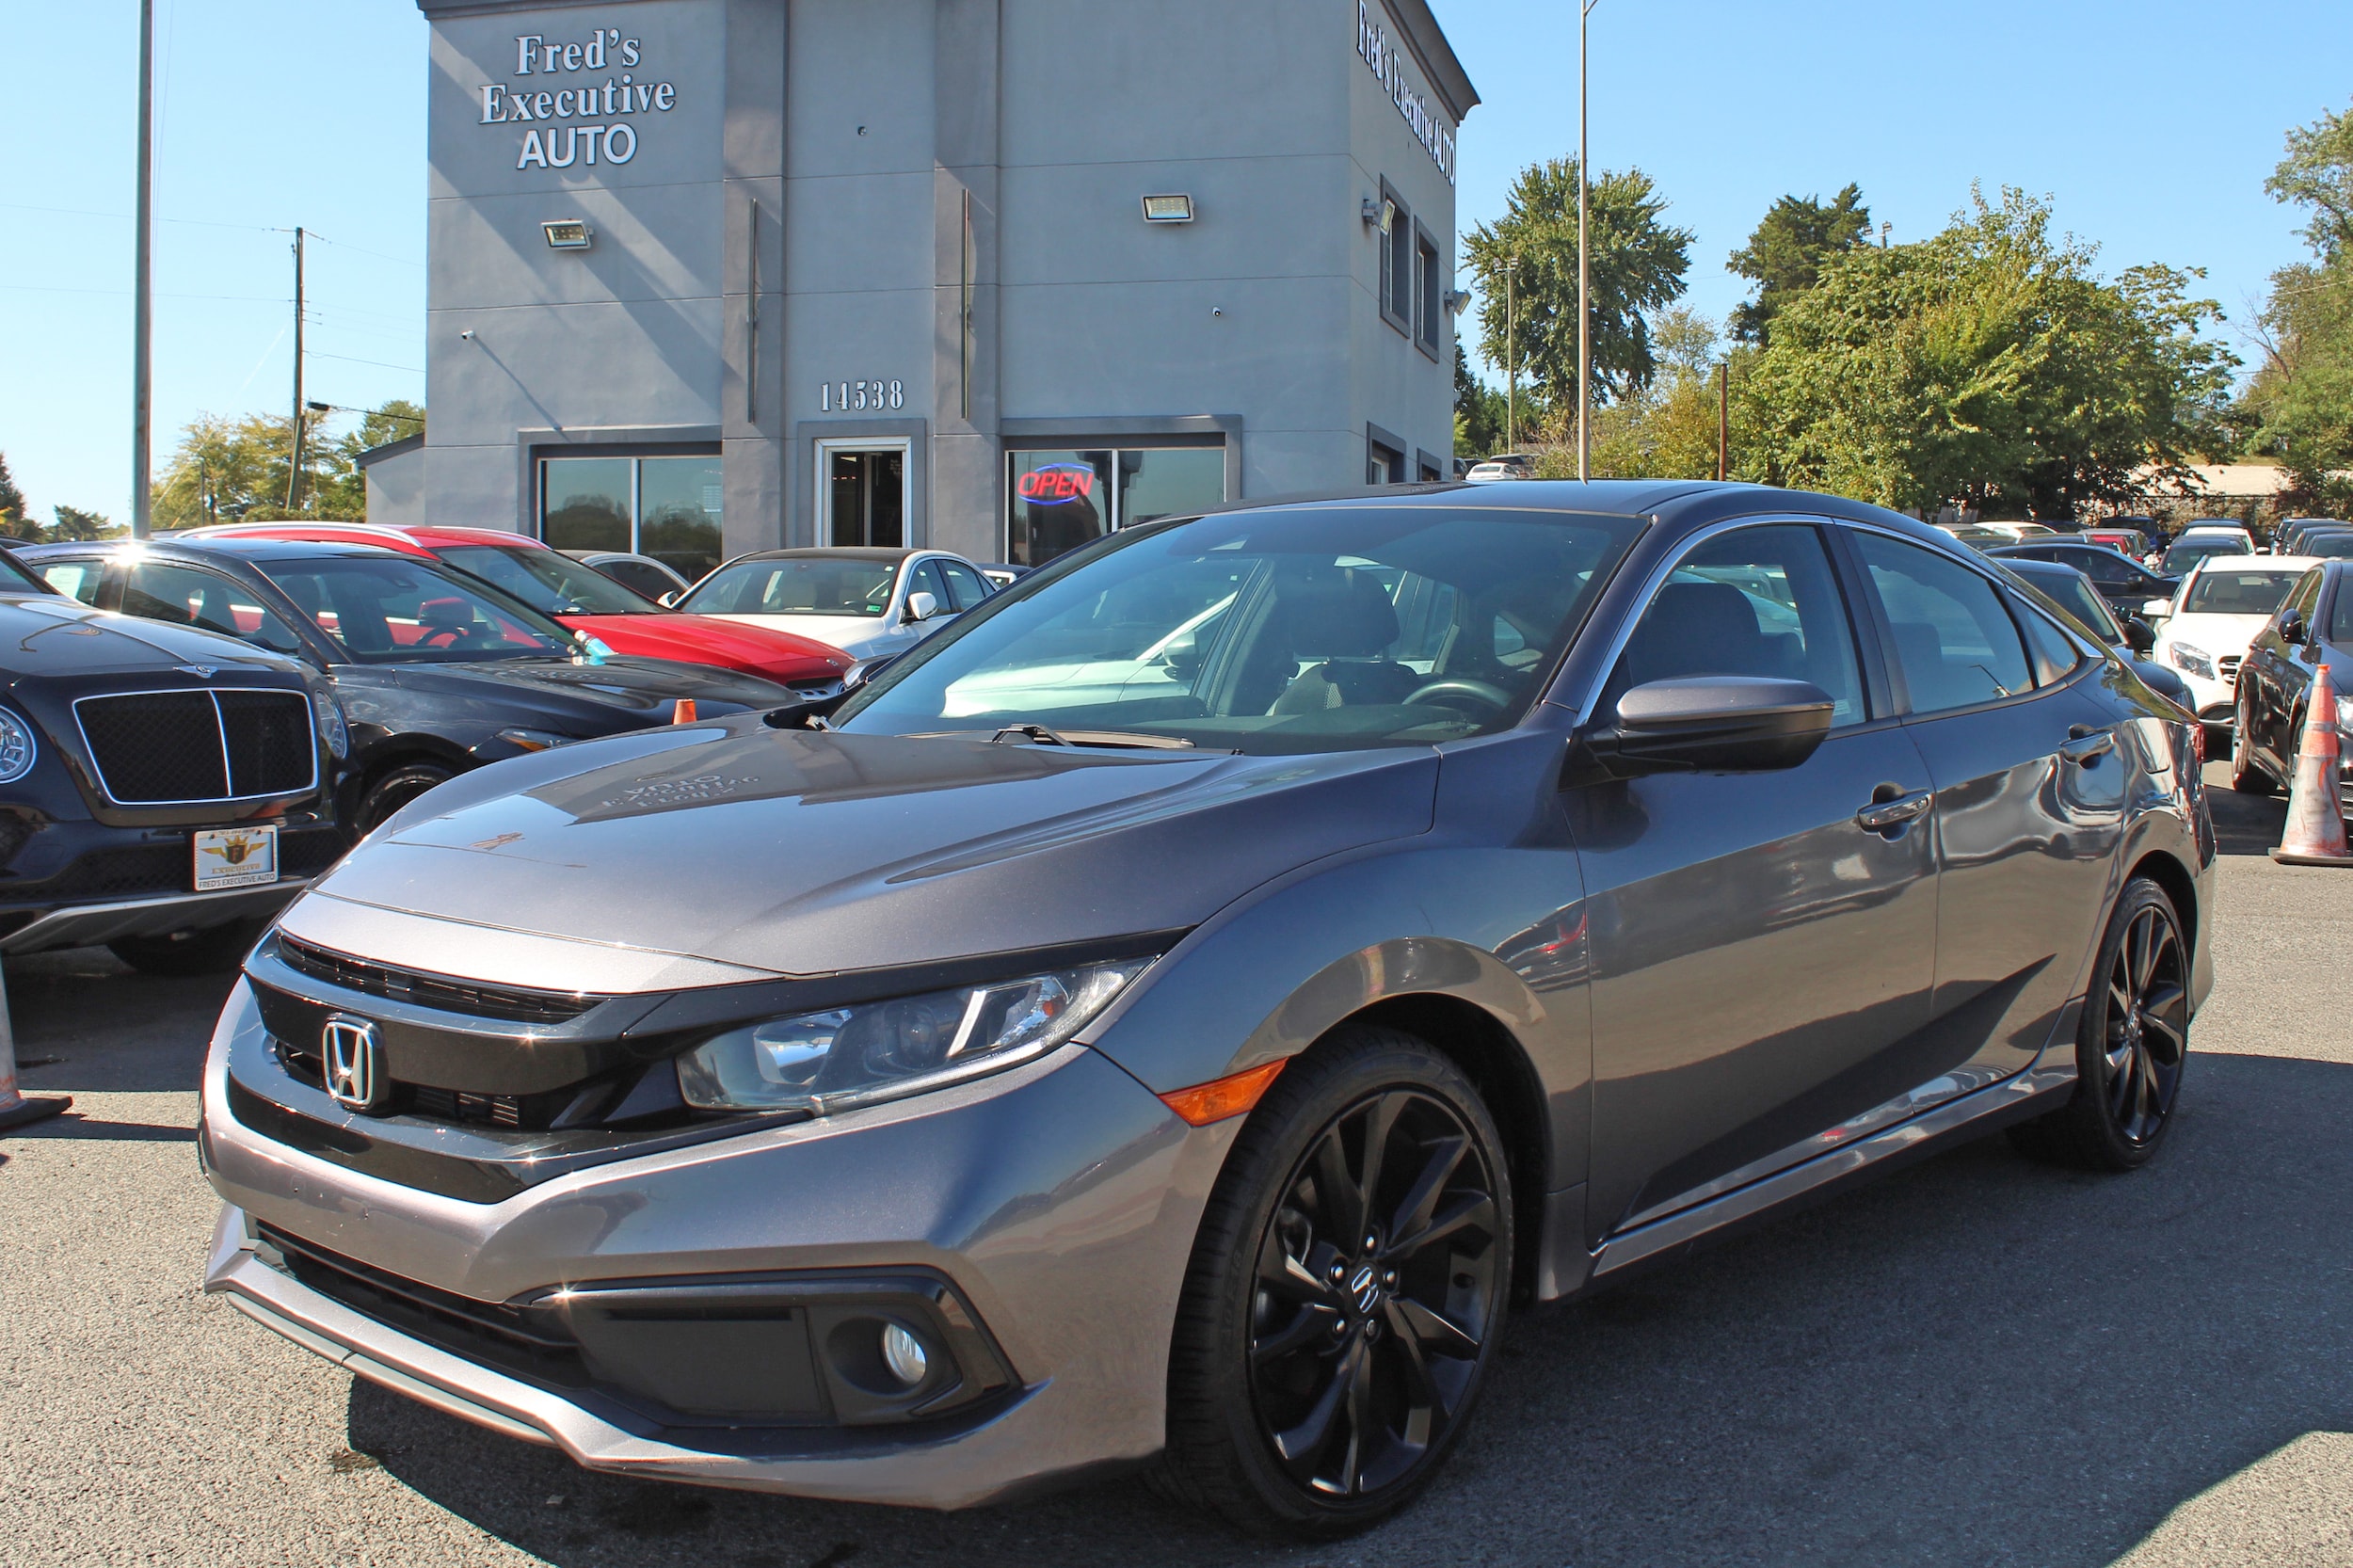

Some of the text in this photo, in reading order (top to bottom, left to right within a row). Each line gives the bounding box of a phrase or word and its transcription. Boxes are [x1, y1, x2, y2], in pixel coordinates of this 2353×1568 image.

[514, 28, 641, 75] Fred's
[478, 74, 676, 124] Executive
[1357, 0, 1456, 187] Fred's Executive AUTO
[517, 122, 638, 169] AUTO
[821, 379, 904, 411] 14538
[1016, 472, 1095, 496] OPEN
[199, 879, 221, 888] FRED'S
[222, 875, 257, 886] EXECUTIVE
[257, 873, 275, 882] AUTO
